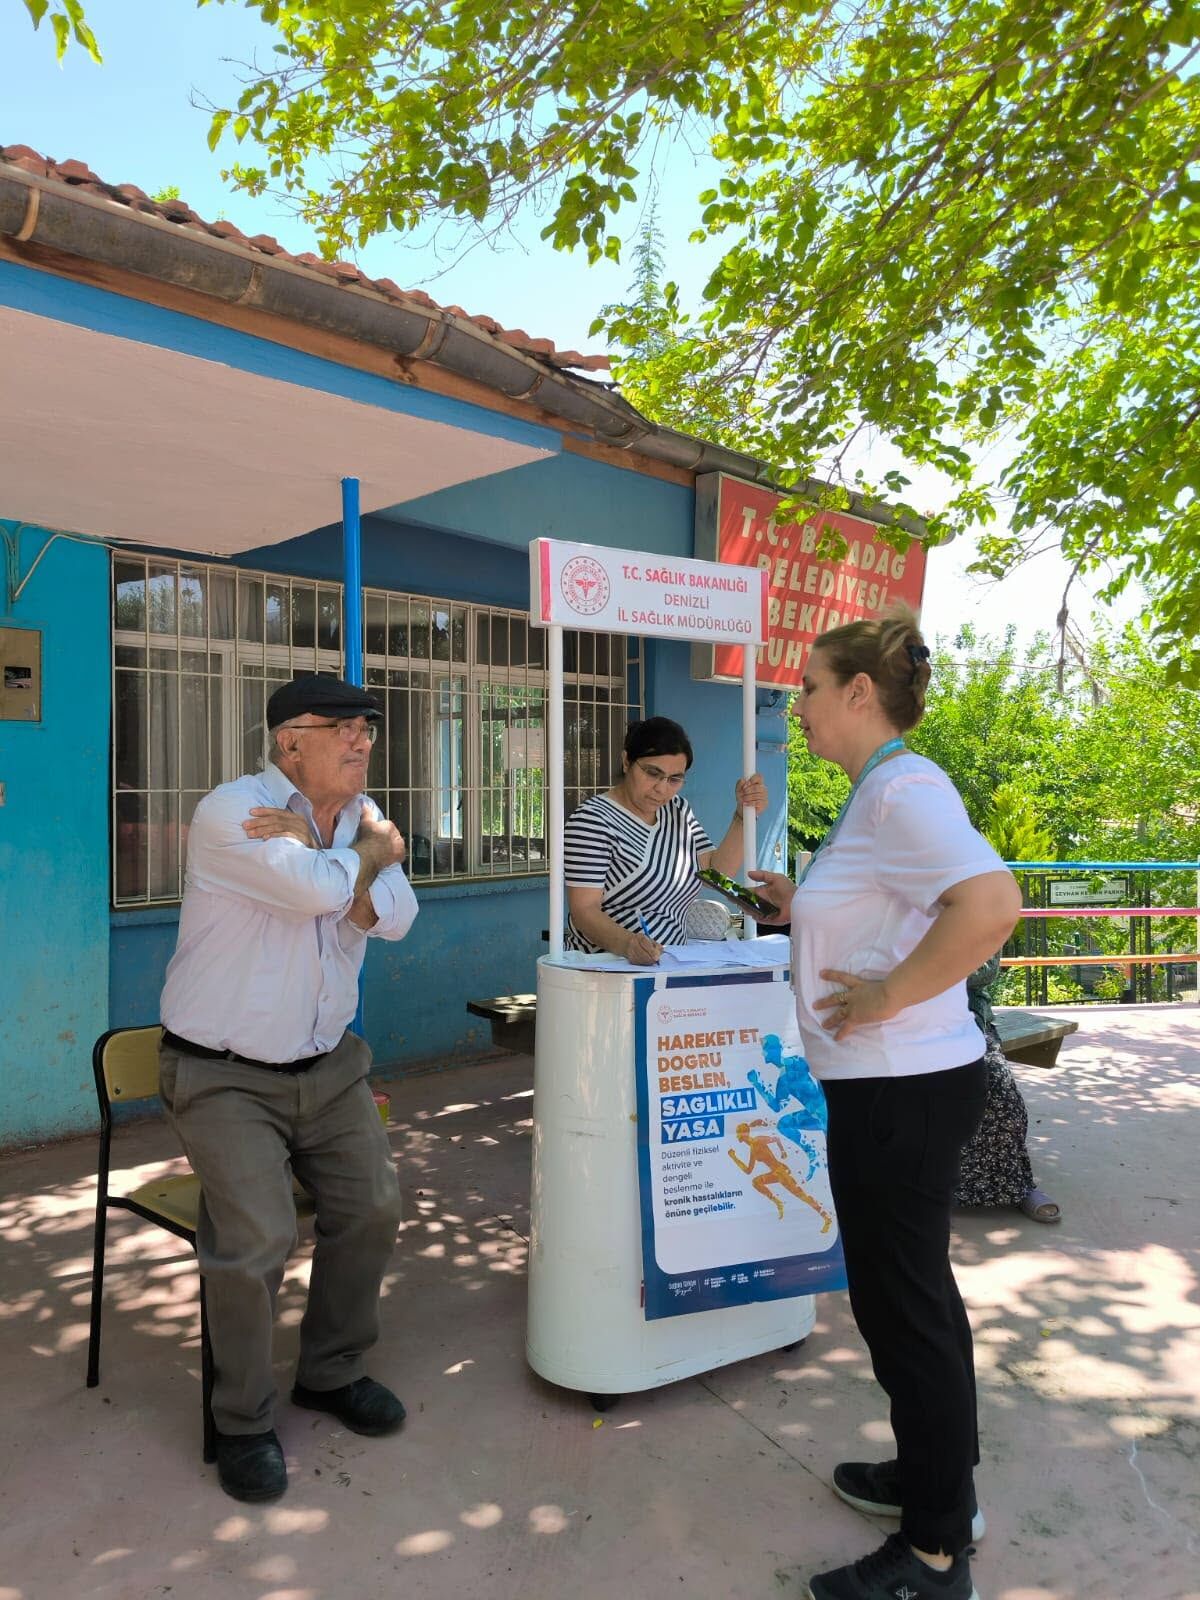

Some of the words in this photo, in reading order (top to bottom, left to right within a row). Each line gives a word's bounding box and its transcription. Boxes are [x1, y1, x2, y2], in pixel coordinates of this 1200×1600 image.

[622, 565, 642, 581] T.C.
[645, 567, 686, 586] SAĞLIK
[689, 574, 748, 593] BAKANLIĞI
[664, 593, 710, 610] DENİZLİ
[618, 607, 628, 622] İL
[631, 610, 675, 627] SAĞLIK
[677, 615, 752, 634] MÜDÜRLÜĞÜ
[657, 1030, 735, 1052] HAREKET
[658, 1072, 731, 1093] BESLEN,
[661, 1148, 691, 1160] Düzenli
[692, 1144, 720, 1156] fiziksel
[662, 1160, 692, 1172] aktivite
[694, 1160, 703, 1168] ve
[662, 1172, 693, 1183] dengeli
[663, 1183, 703, 1195] beslenme
[704, 1181, 714, 1190] ile
[664, 1194, 692, 1207] kronik
[692, 1189, 743, 1203] hastalıkların
[665, 1208, 692, 1219] önüne
[693, 1201, 736, 1217] geçilebilir.
